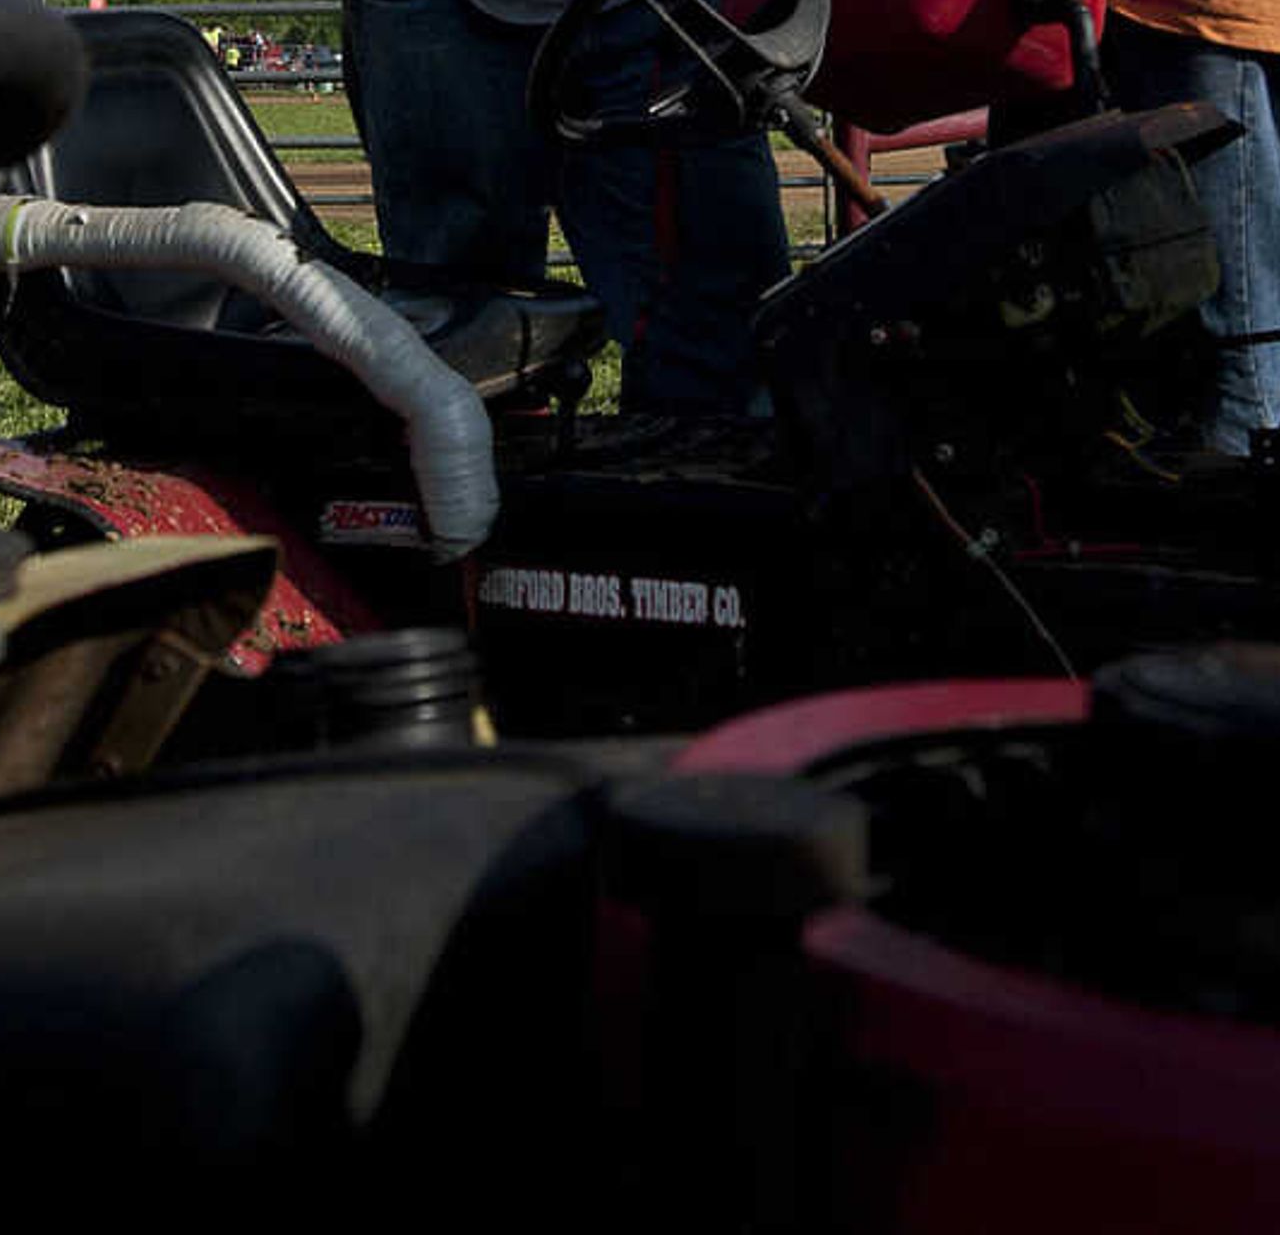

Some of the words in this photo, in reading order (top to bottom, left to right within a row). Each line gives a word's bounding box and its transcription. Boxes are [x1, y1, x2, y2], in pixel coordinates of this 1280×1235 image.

[568, 572, 627, 618] BROS.
[631, 577, 709, 624] TIMBER
[713, 585, 747, 628] CO.
